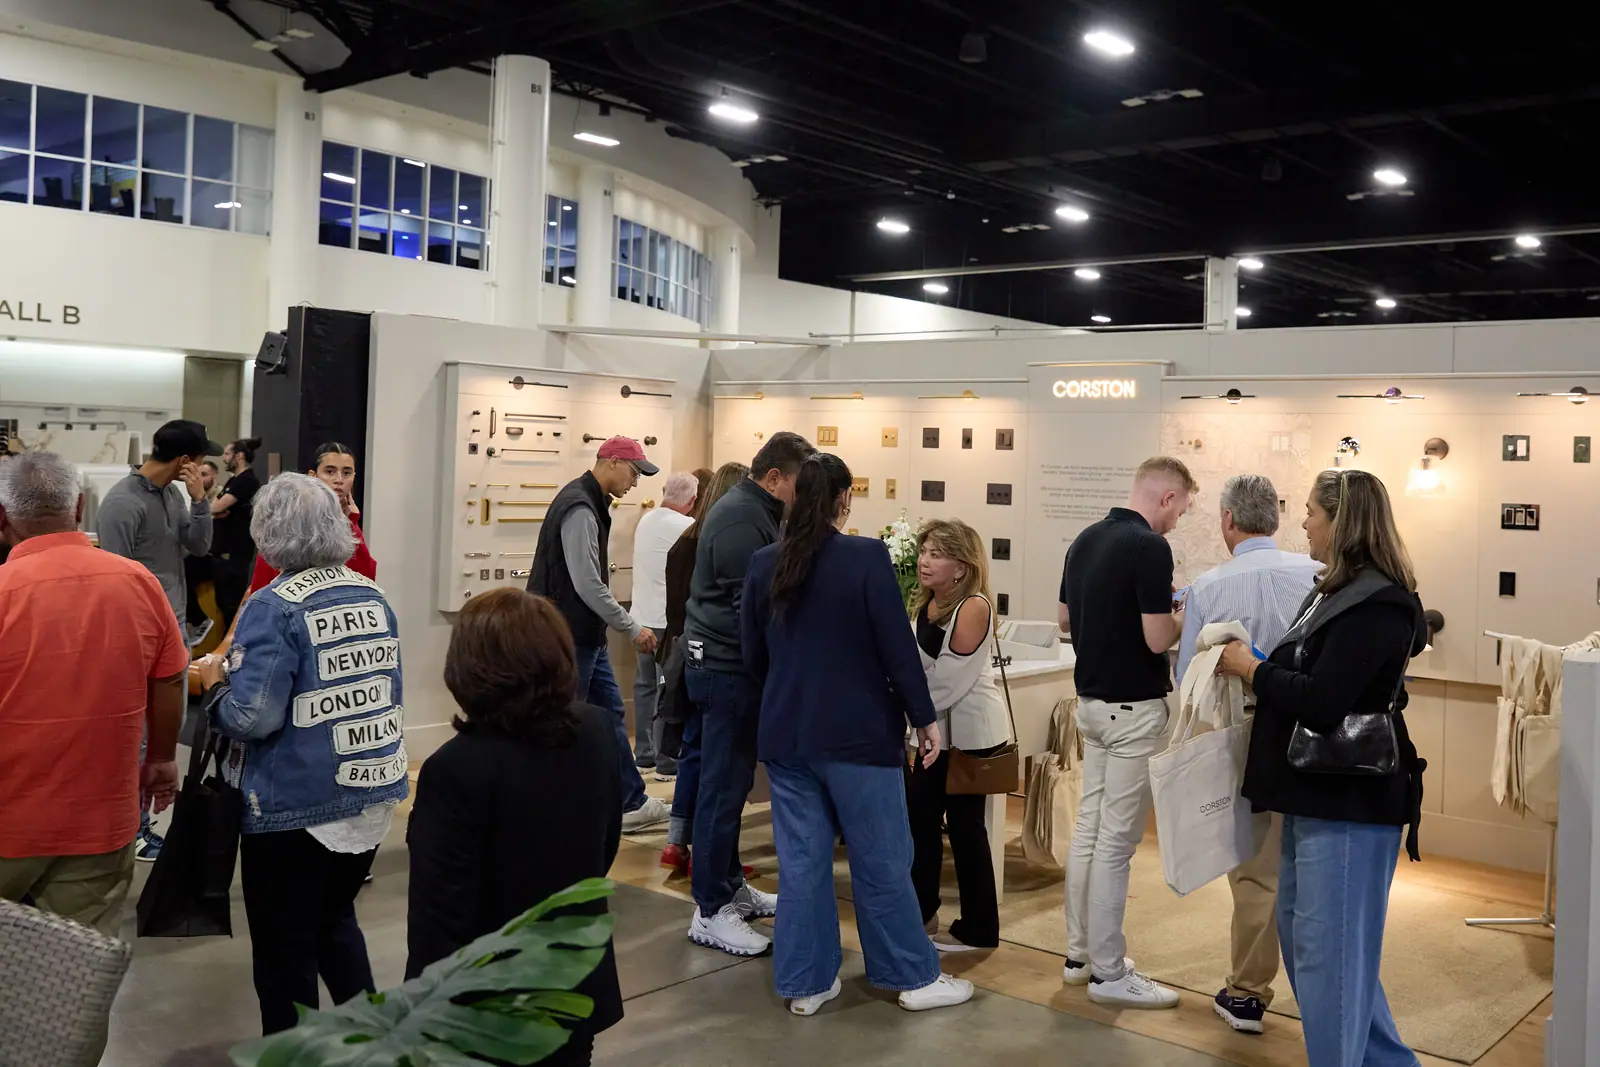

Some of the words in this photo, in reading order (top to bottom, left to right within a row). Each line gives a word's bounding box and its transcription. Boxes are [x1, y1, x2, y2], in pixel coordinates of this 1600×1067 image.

[0, 299, 53, 323] ALL
[63, 305, 81, 325] B
[1052, 379, 1137, 399] CORSTON
[285, 565, 346, 597] FASHION
[315, 609, 379, 638] PARIS
[348, 766, 387, 782] BACK
